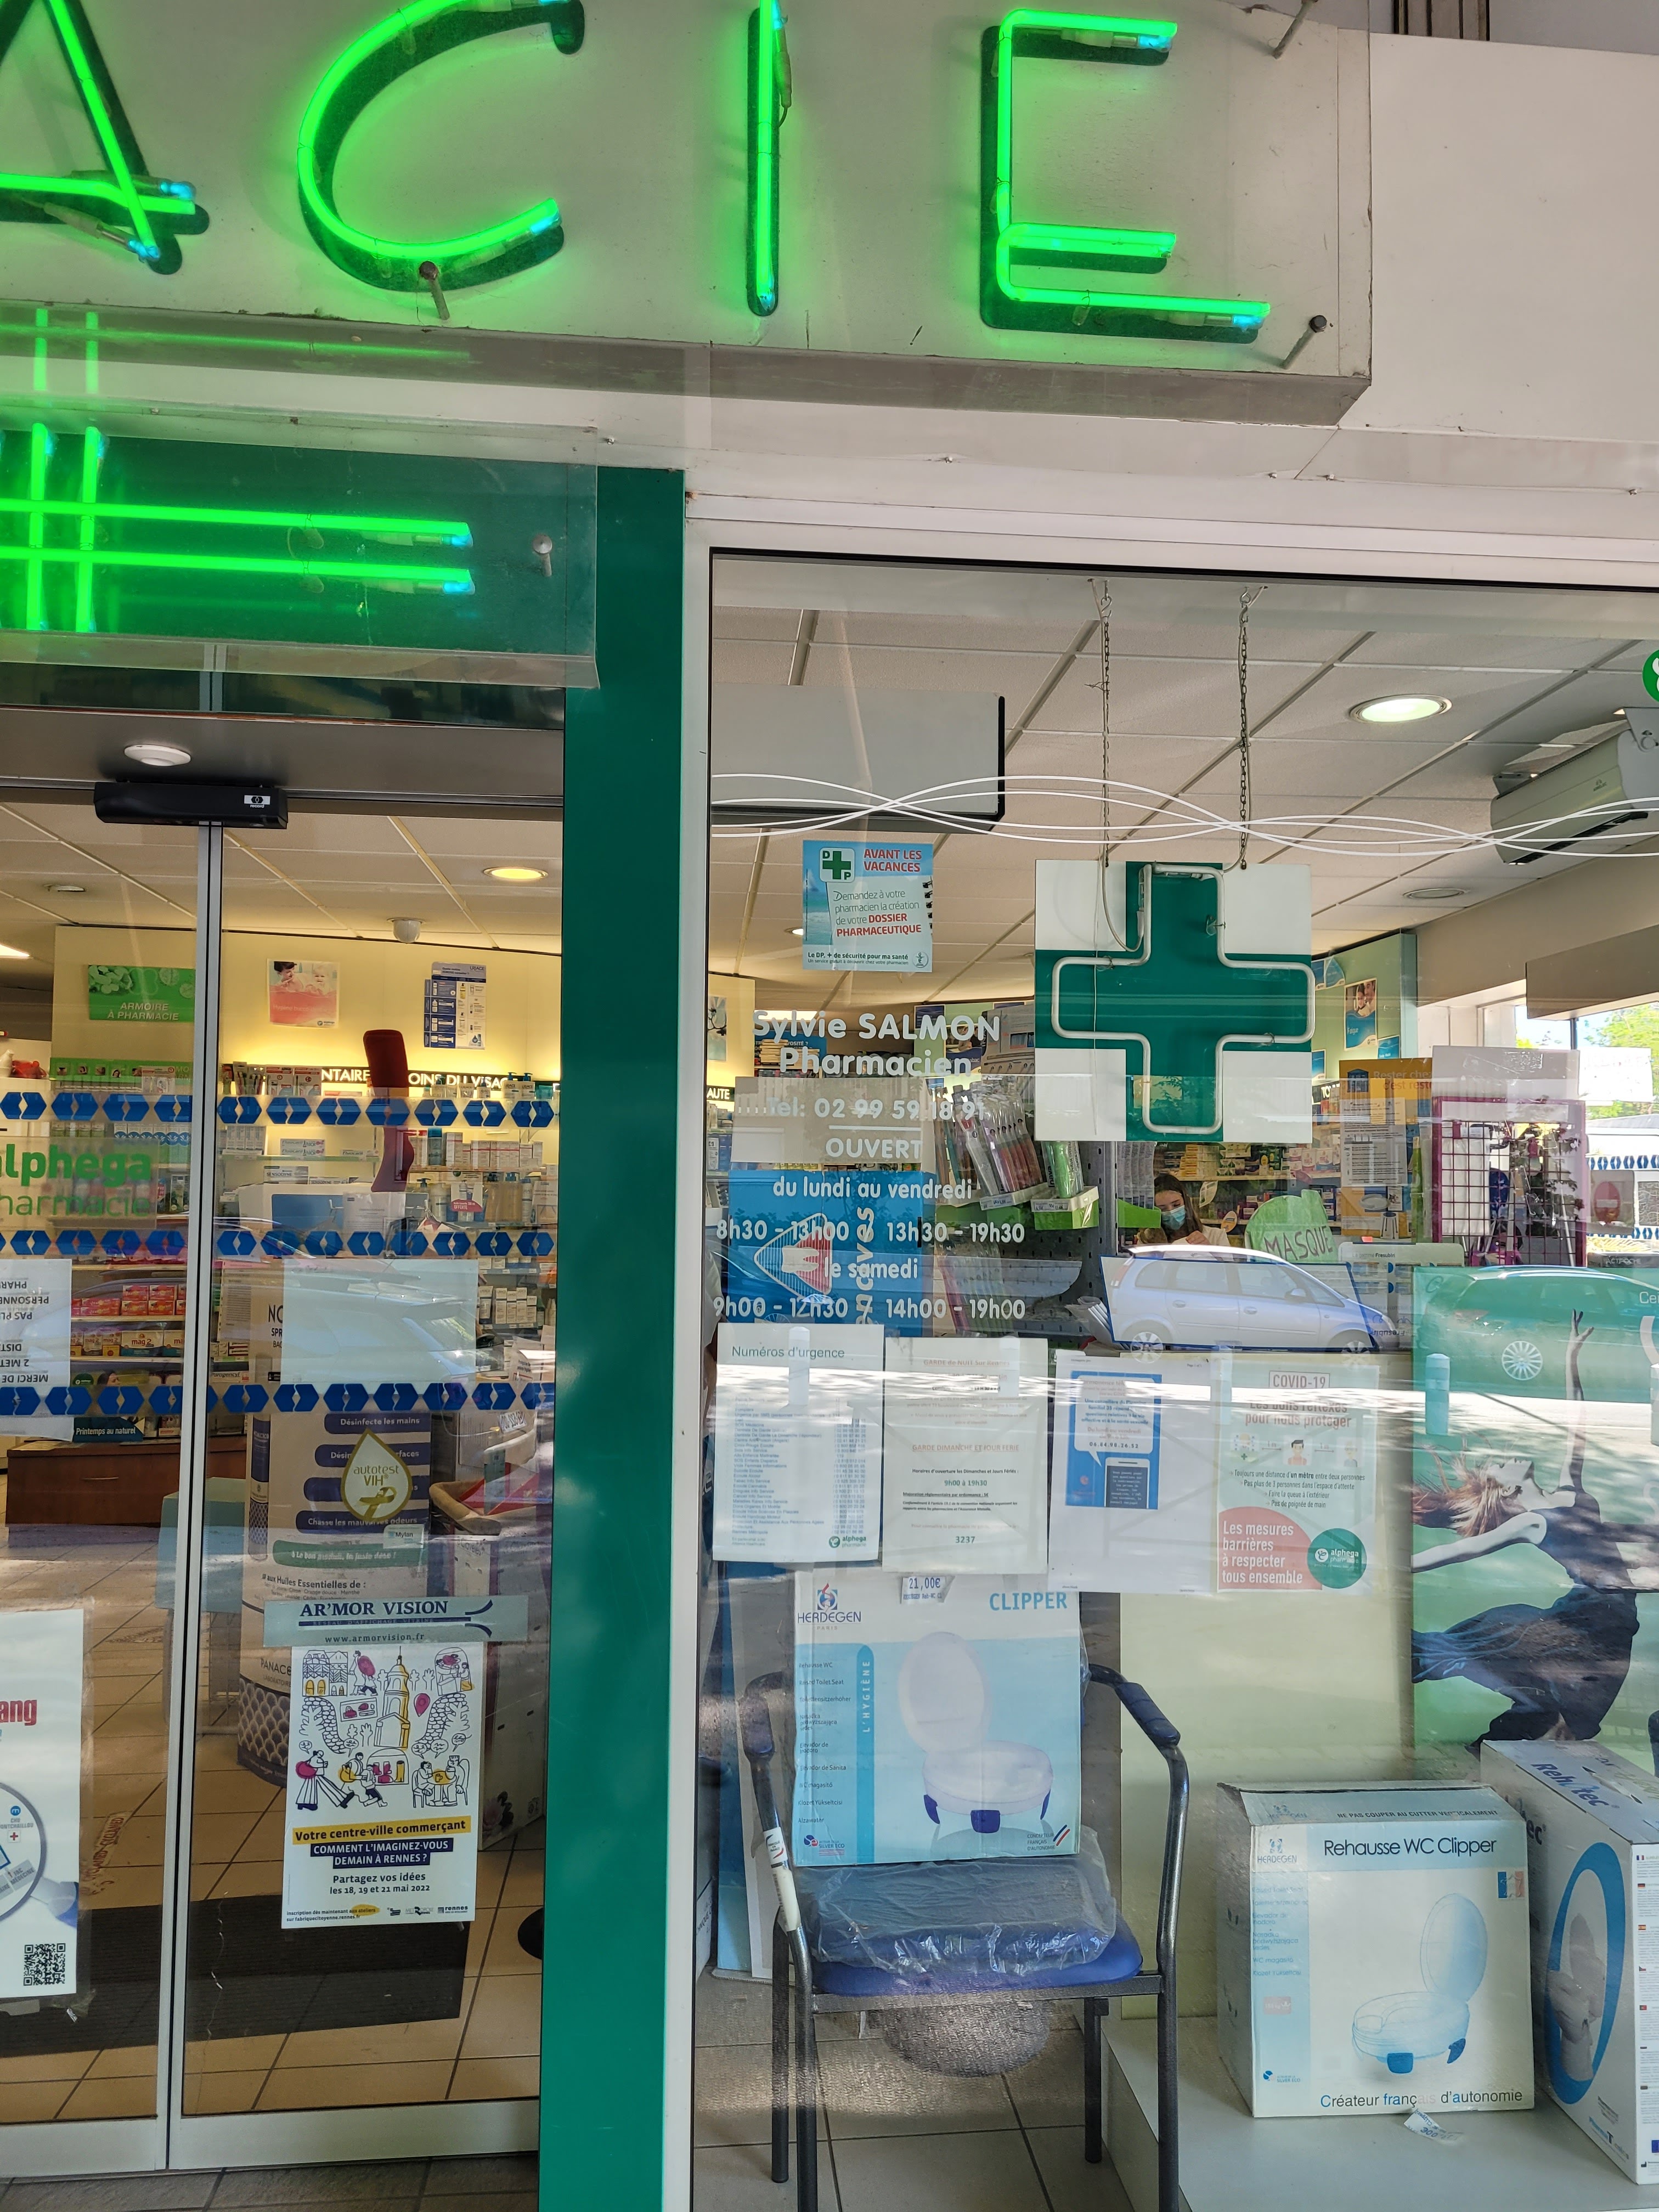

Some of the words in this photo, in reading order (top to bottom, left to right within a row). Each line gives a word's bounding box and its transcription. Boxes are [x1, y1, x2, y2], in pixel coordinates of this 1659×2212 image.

[823, 850, 830, 859] D
[864, 849, 900, 859] AVANT
[904, 850, 922, 860] LES
[864, 861, 921, 872] VACANCES
[844, 872, 851, 880] P
[833, 891, 878, 901] Demandez
[879, 890, 884, 898] à
[835, 904, 878, 915] pharmacien
[889, 901, 919, 910] création
[836, 917, 845, 925] de
[868, 913, 907, 923] DOSSIER
[837, 924, 921, 937] PHARMACEUTIQUE
[121, 1002, 169, 1011] ARMOIRE
[107, 1010, 115, 1019] À
[118, 1012, 179, 1021] PHARMACIE
[752, 1009, 847, 1043] Sylvie
[859, 1013, 1000, 1041] SALMON
[780, 1047, 972, 1077] Pharmacien
[1374, 1070, 1408, 1079] Rester
[814, 1099, 845, 1118] 02
[855, 1099, 883, 1119] 99
[893, 1100, 921, 1119] 59
[826, 1138, 923, 1159] OUVERT
[0, 1143, 151, 1187] lphega
[772, 1177, 797, 1197] du
[804, 1176, 850, 1198] lundi
[857, 1181, 880, 1198] au
[888, 1178, 972, 1199] vendredi
[716, 1219, 768, 1240] 8h30
[791, 1220, 849, 1241] 13h00
[887, 1222, 947, 1243] 13h30
[970, 1223, 1025, 1244] 19h30
[1264, 1226, 1333, 1261] MASQUE
[824, 1257, 840, 1278] le
[848, 1258, 918, 1279] samedi
[713, 1297, 766, 1317] 9h00
[790, 1298, 848, 1318] 12h30
[886, 1299, 947, 1319] 14h00
[970, 1299, 1025, 1319] 19h00
[732, 1346, 785, 1357] Numéros
[788, 1346, 845, 1359] d'urgence
[17, 1374, 48, 1383] MERCI
[1273, 1374, 1325, 1389] COVID-19
[353, 1465, 399, 1474] autotest
[1234, 1469, 1254, 1478] Toujours
[1223, 1521, 1242, 1534] Les
[1246, 1523, 1294, 1536] mesures
[1223, 1537, 1273, 1551] barrières
[1330, 1549, 1359, 1557] alphega
[1222, 1555, 1228, 1566] à
[1232, 1555, 1285, 1570] respecter
[277, 1576, 296, 1586] Huiles
[298, 1579, 347, 1588] Essentielles
[909, 1578, 941, 1590] 21,00€
[1222, 1571, 1245, 1583] tous
[1249, 1571, 1303, 1584] ensemble
[989, 1592, 1068, 1611] CLIPPER
[300, 1602, 376, 1617] AR'MOR
[383, 1601, 448, 1615] VISION
[798, 1611, 861, 1623] HERDEGEN
[325, 1633, 425, 1643] www.armorvision.fr
[860, 1661, 870, 1732] L'HYGIÈNE
[0, 1700, 37, 1726] ang
[295, 1831, 327, 1841] Votre
[329, 1824, 393, 1839] centre-ville
[396, 1820, 466, 1834] commerçant
[313, 1844, 363, 1854] COMMENT
[365, 1840, 449, 1852] L'IMAGINEZ-VOUS
[1324, 1839, 1401, 1857] Rehausse
[1404, 1838, 1435, 1854] WC
[1437, 1837, 1497, 1857] Clipper
[335, 1855, 373, 1865] DEMAIN
[375, 1854, 381, 1864] À
[383, 1854, 421, 1864] RENNES
[1257, 1855, 1297, 1863] HERDEGEN
[333, 1874, 377, 1884] Partagez
[399, 1872, 426, 1881] idées
[344, 1886, 356, 1894] 18,
[1321, 2094, 1379, 2108] Créateur
[1441, 2089, 1523, 2104] d'autonomie
